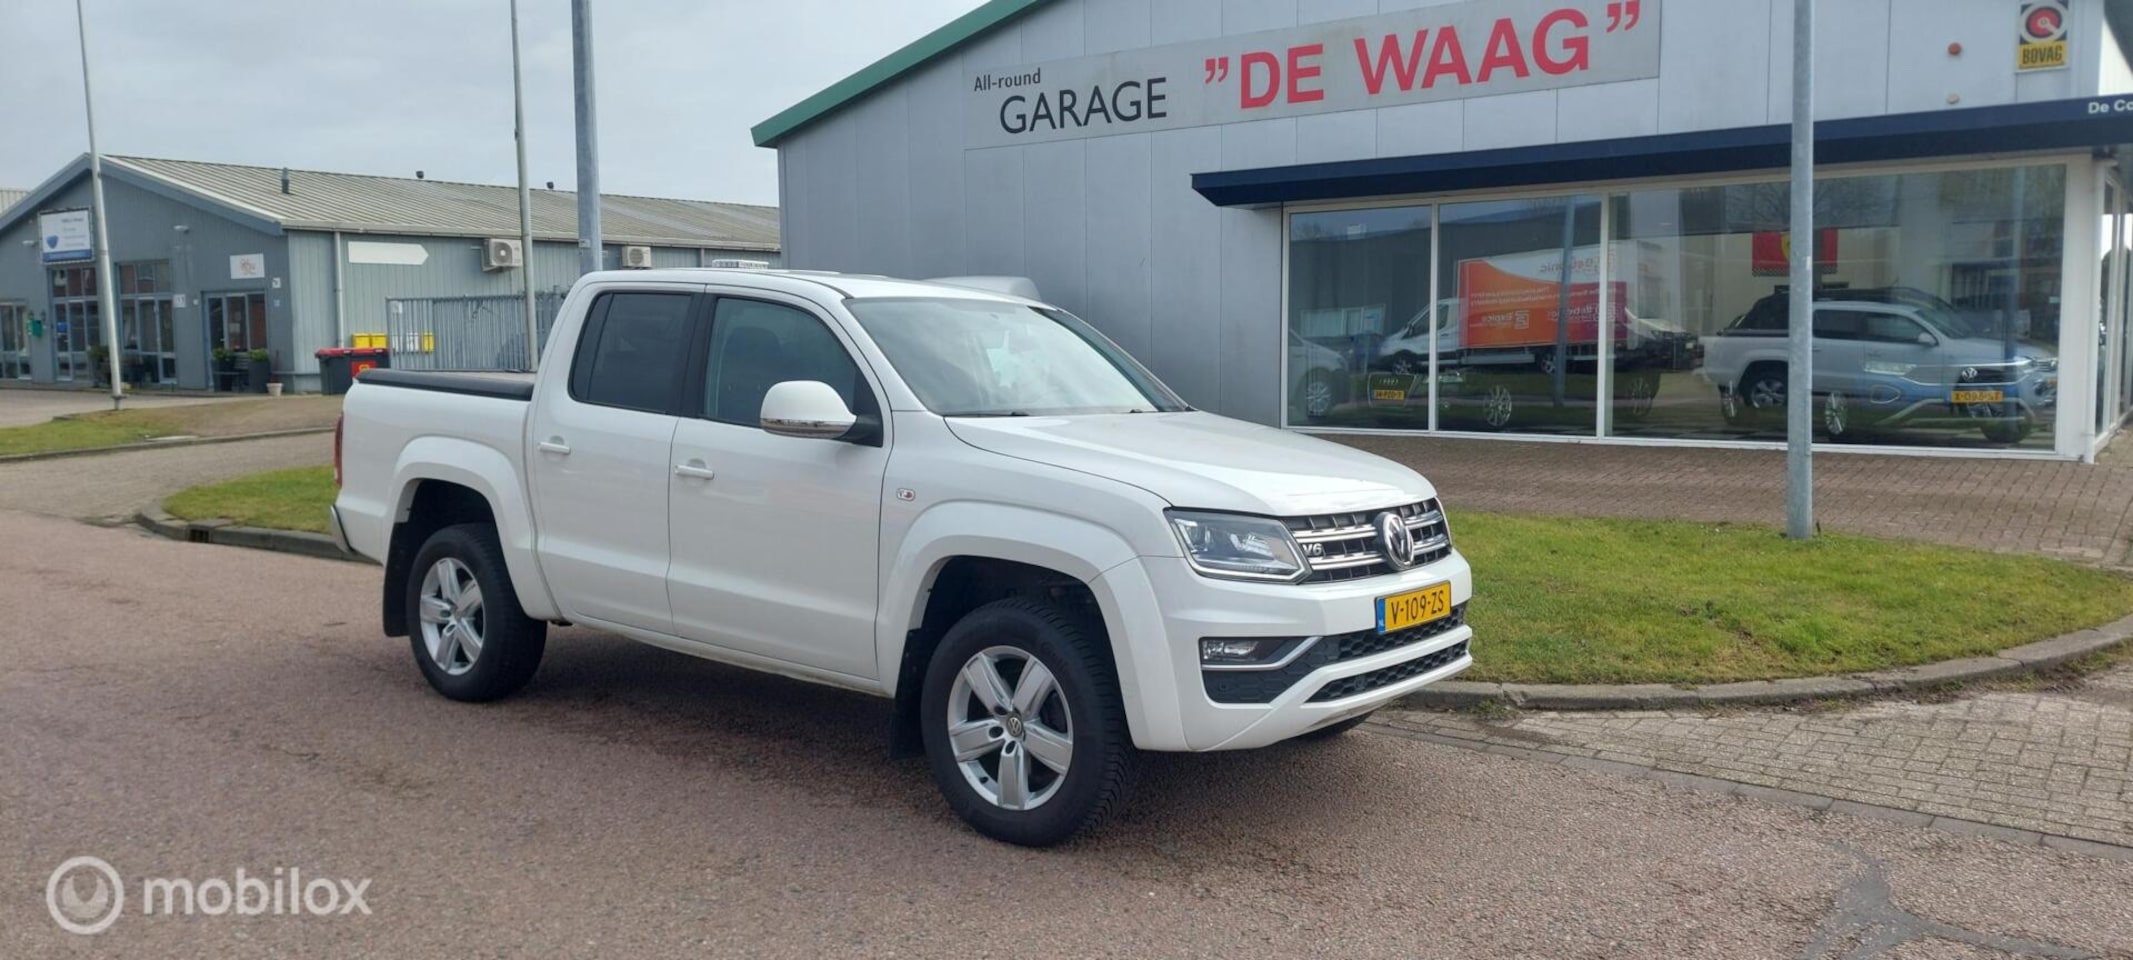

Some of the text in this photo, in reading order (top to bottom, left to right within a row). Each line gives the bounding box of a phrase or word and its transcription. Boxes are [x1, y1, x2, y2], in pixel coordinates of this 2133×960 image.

[2022, 45, 2064, 65] BOVAG
[974, 67, 1041, 92] All-round
[1000, 77, 1167, 134] GARAGE
[2088, 102, 2110, 114] De
[1302, 543, 1322, 556] V6
[1391, 590, 1444, 625] V-109-ZS
